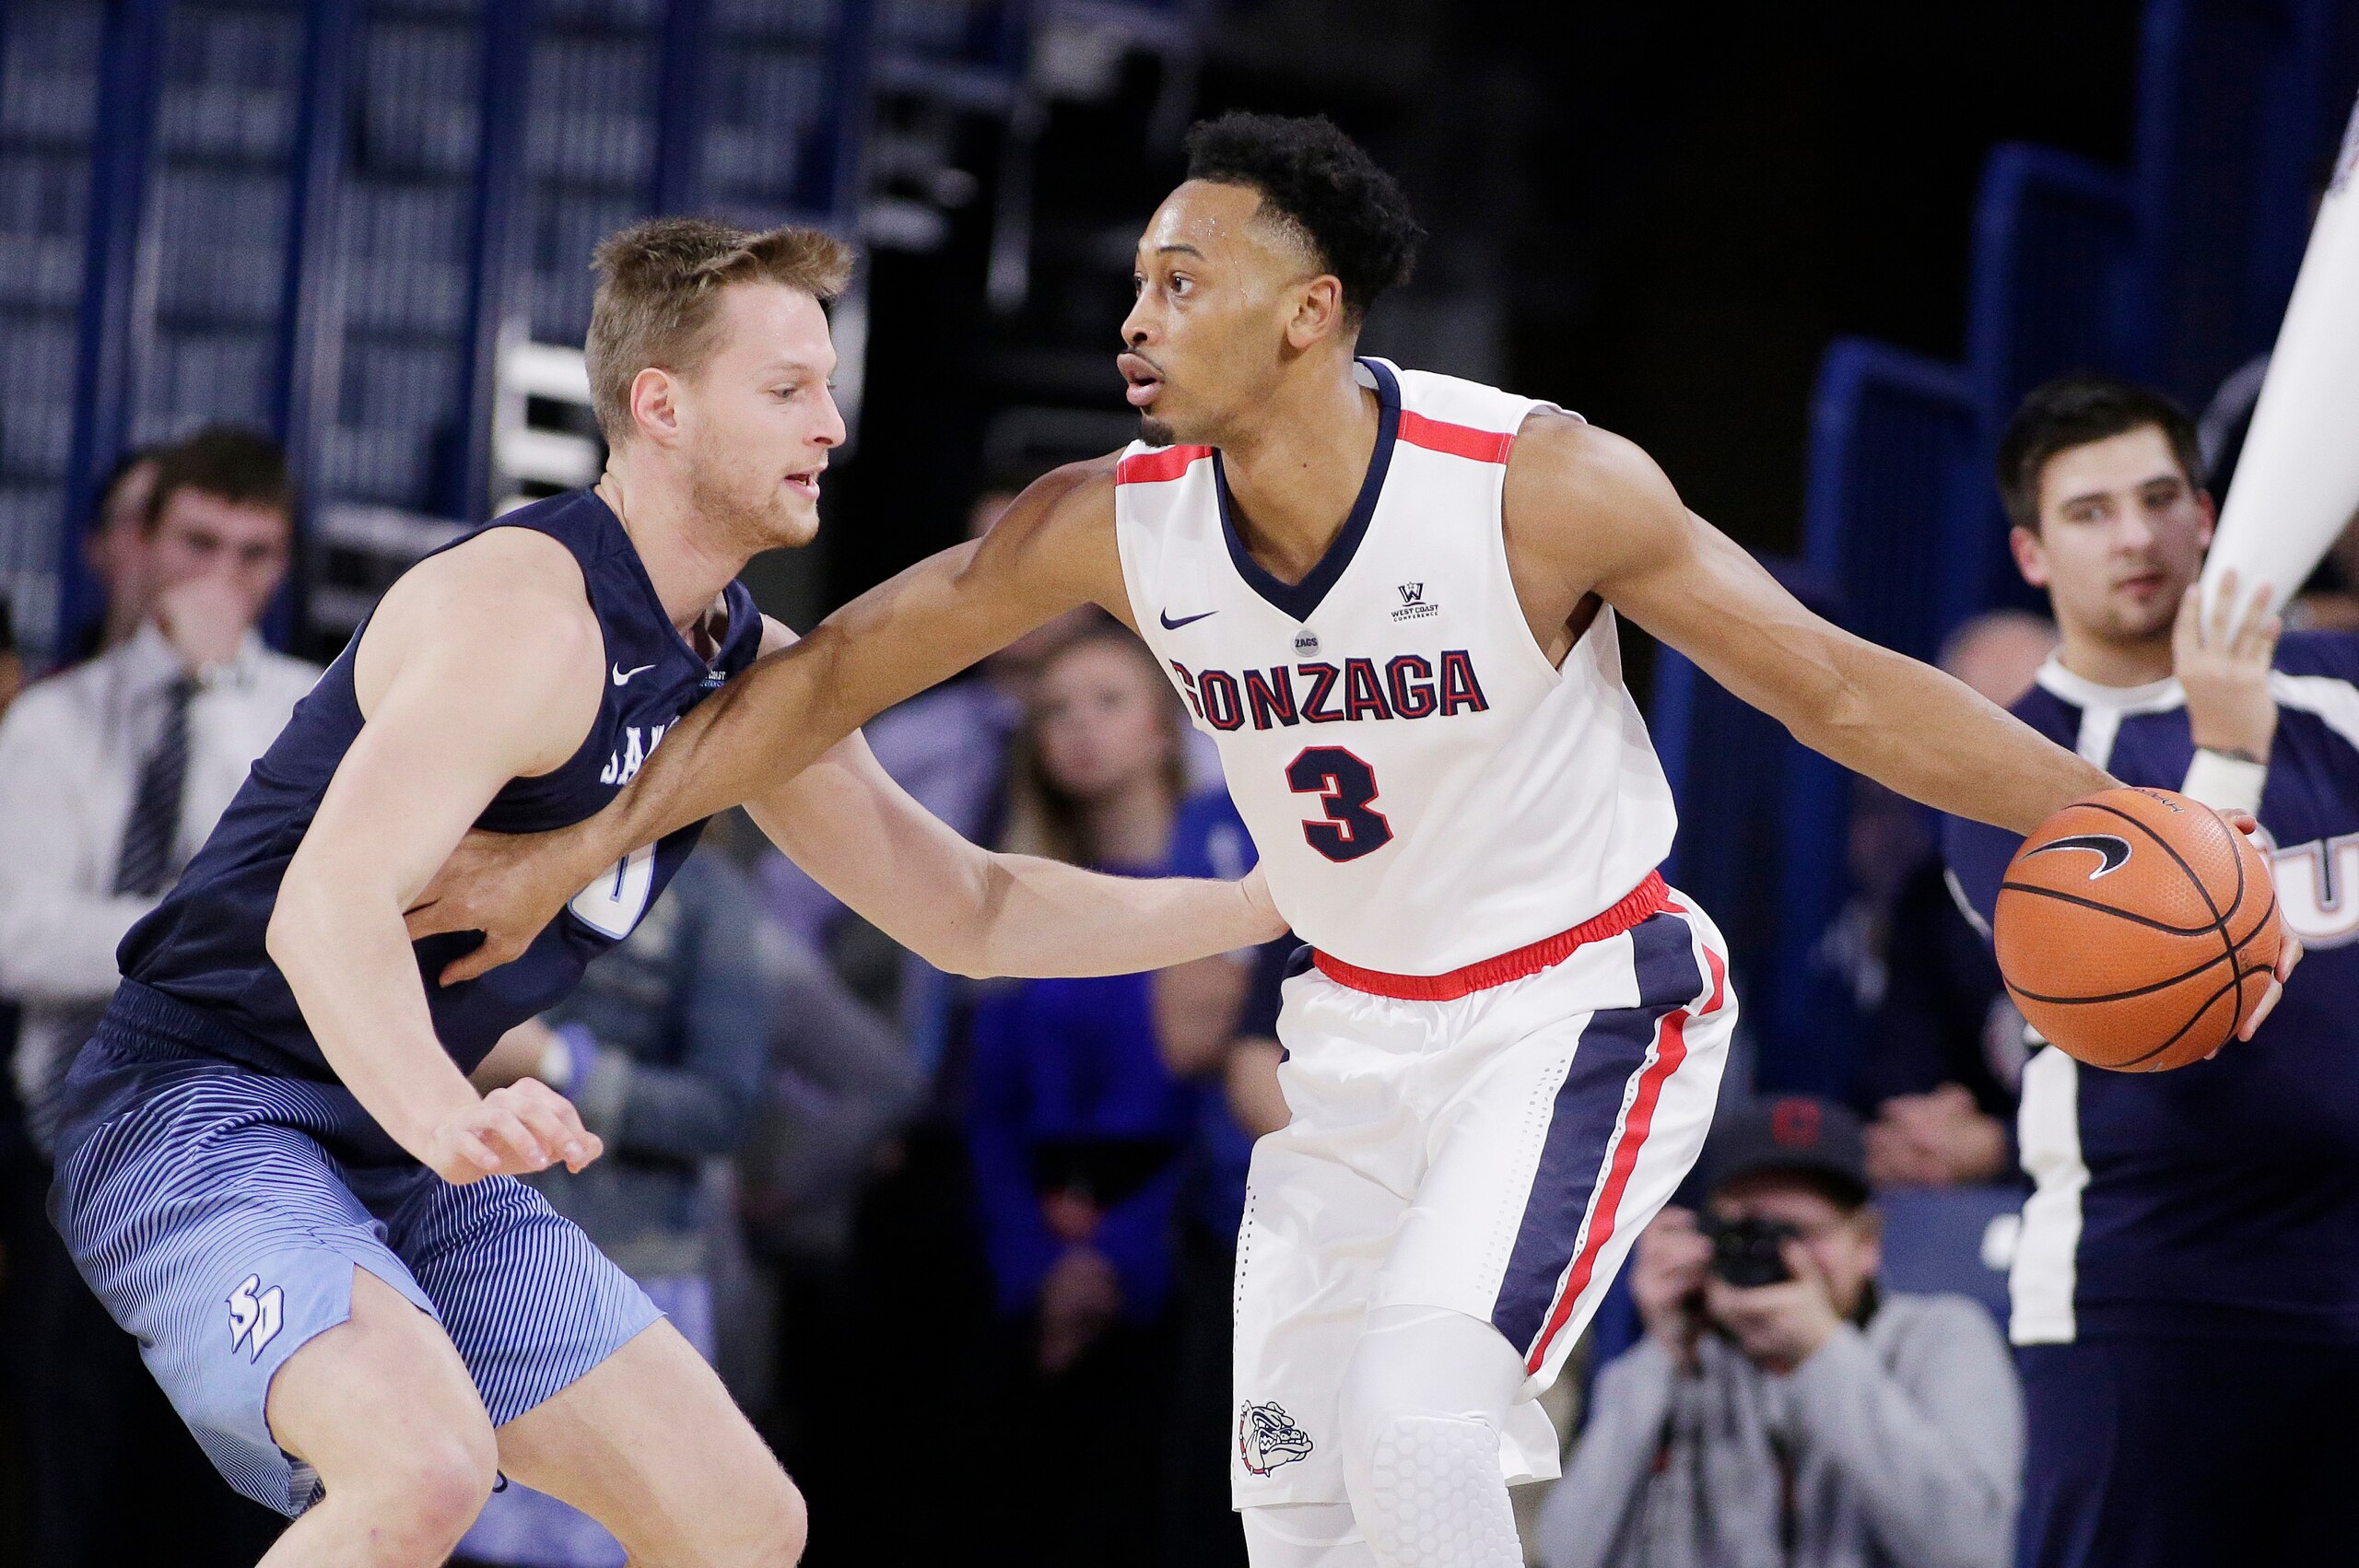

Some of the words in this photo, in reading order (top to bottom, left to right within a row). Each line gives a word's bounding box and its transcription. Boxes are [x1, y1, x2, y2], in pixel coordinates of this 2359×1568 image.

[1391, 608, 1414, 617] WEST
[1414, 603, 1438, 614] COAST
[1393, 611, 1438, 622] CONFERENCE
[1295, 638, 1318, 648] ZAGS
[1285, 745, 1394, 862] 3
[225, 1273, 285, 1365] SD
